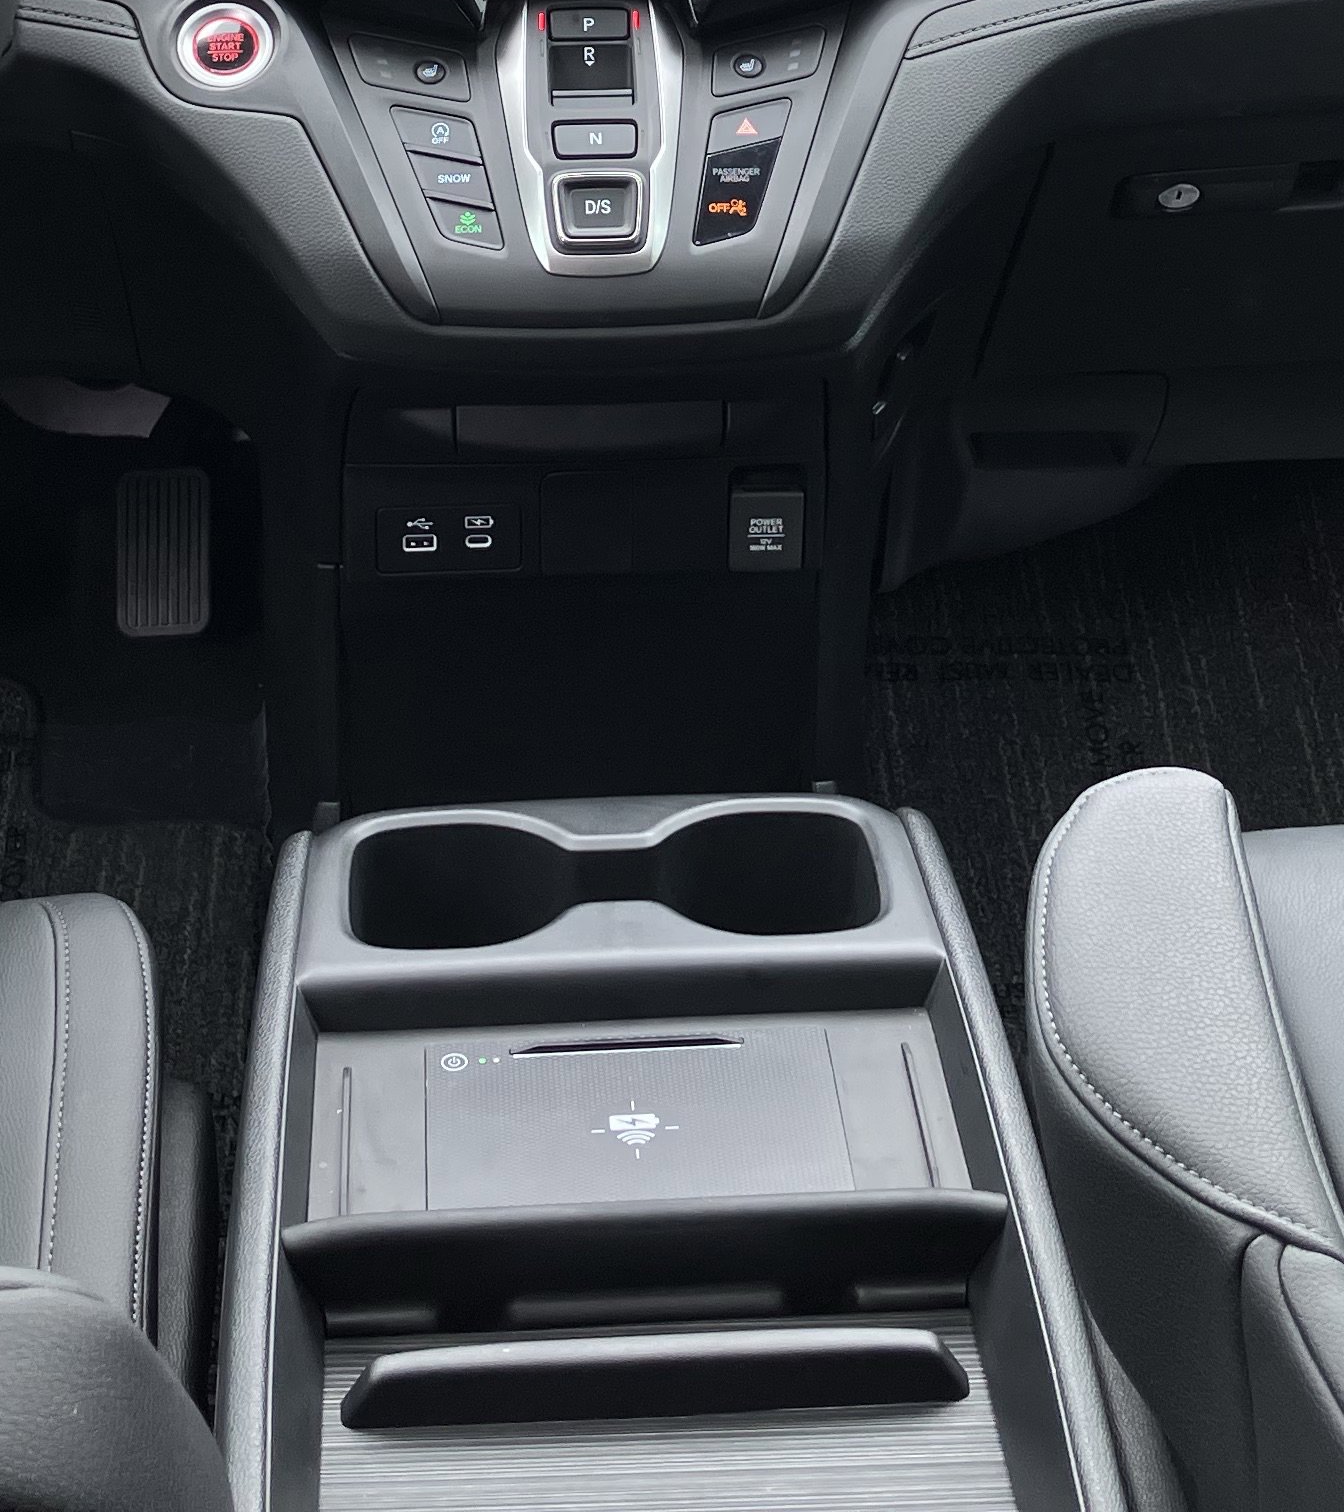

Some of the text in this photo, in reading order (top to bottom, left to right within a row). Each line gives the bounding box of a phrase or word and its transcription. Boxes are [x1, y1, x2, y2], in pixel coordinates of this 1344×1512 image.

[583, 17, 595, 32] P
[207, 33, 244, 42] ENGINE
[209, 42, 241, 51] START
[211, 52, 238, 62] STOP
[584, 46, 595, 61] R
[589, 132, 602, 145] N
[712, 167, 760, 177] PASSENGER
[437, 173, 471, 184] SNOW
[719, 175, 750, 183] AIRBAG
[584, 199, 611, 215] D/S
[708, 202, 729, 213] OFF
[455, 224, 482, 234] ECON
[750, 518, 783, 526] POWER
[748, 525, 783, 534] OUTLET
